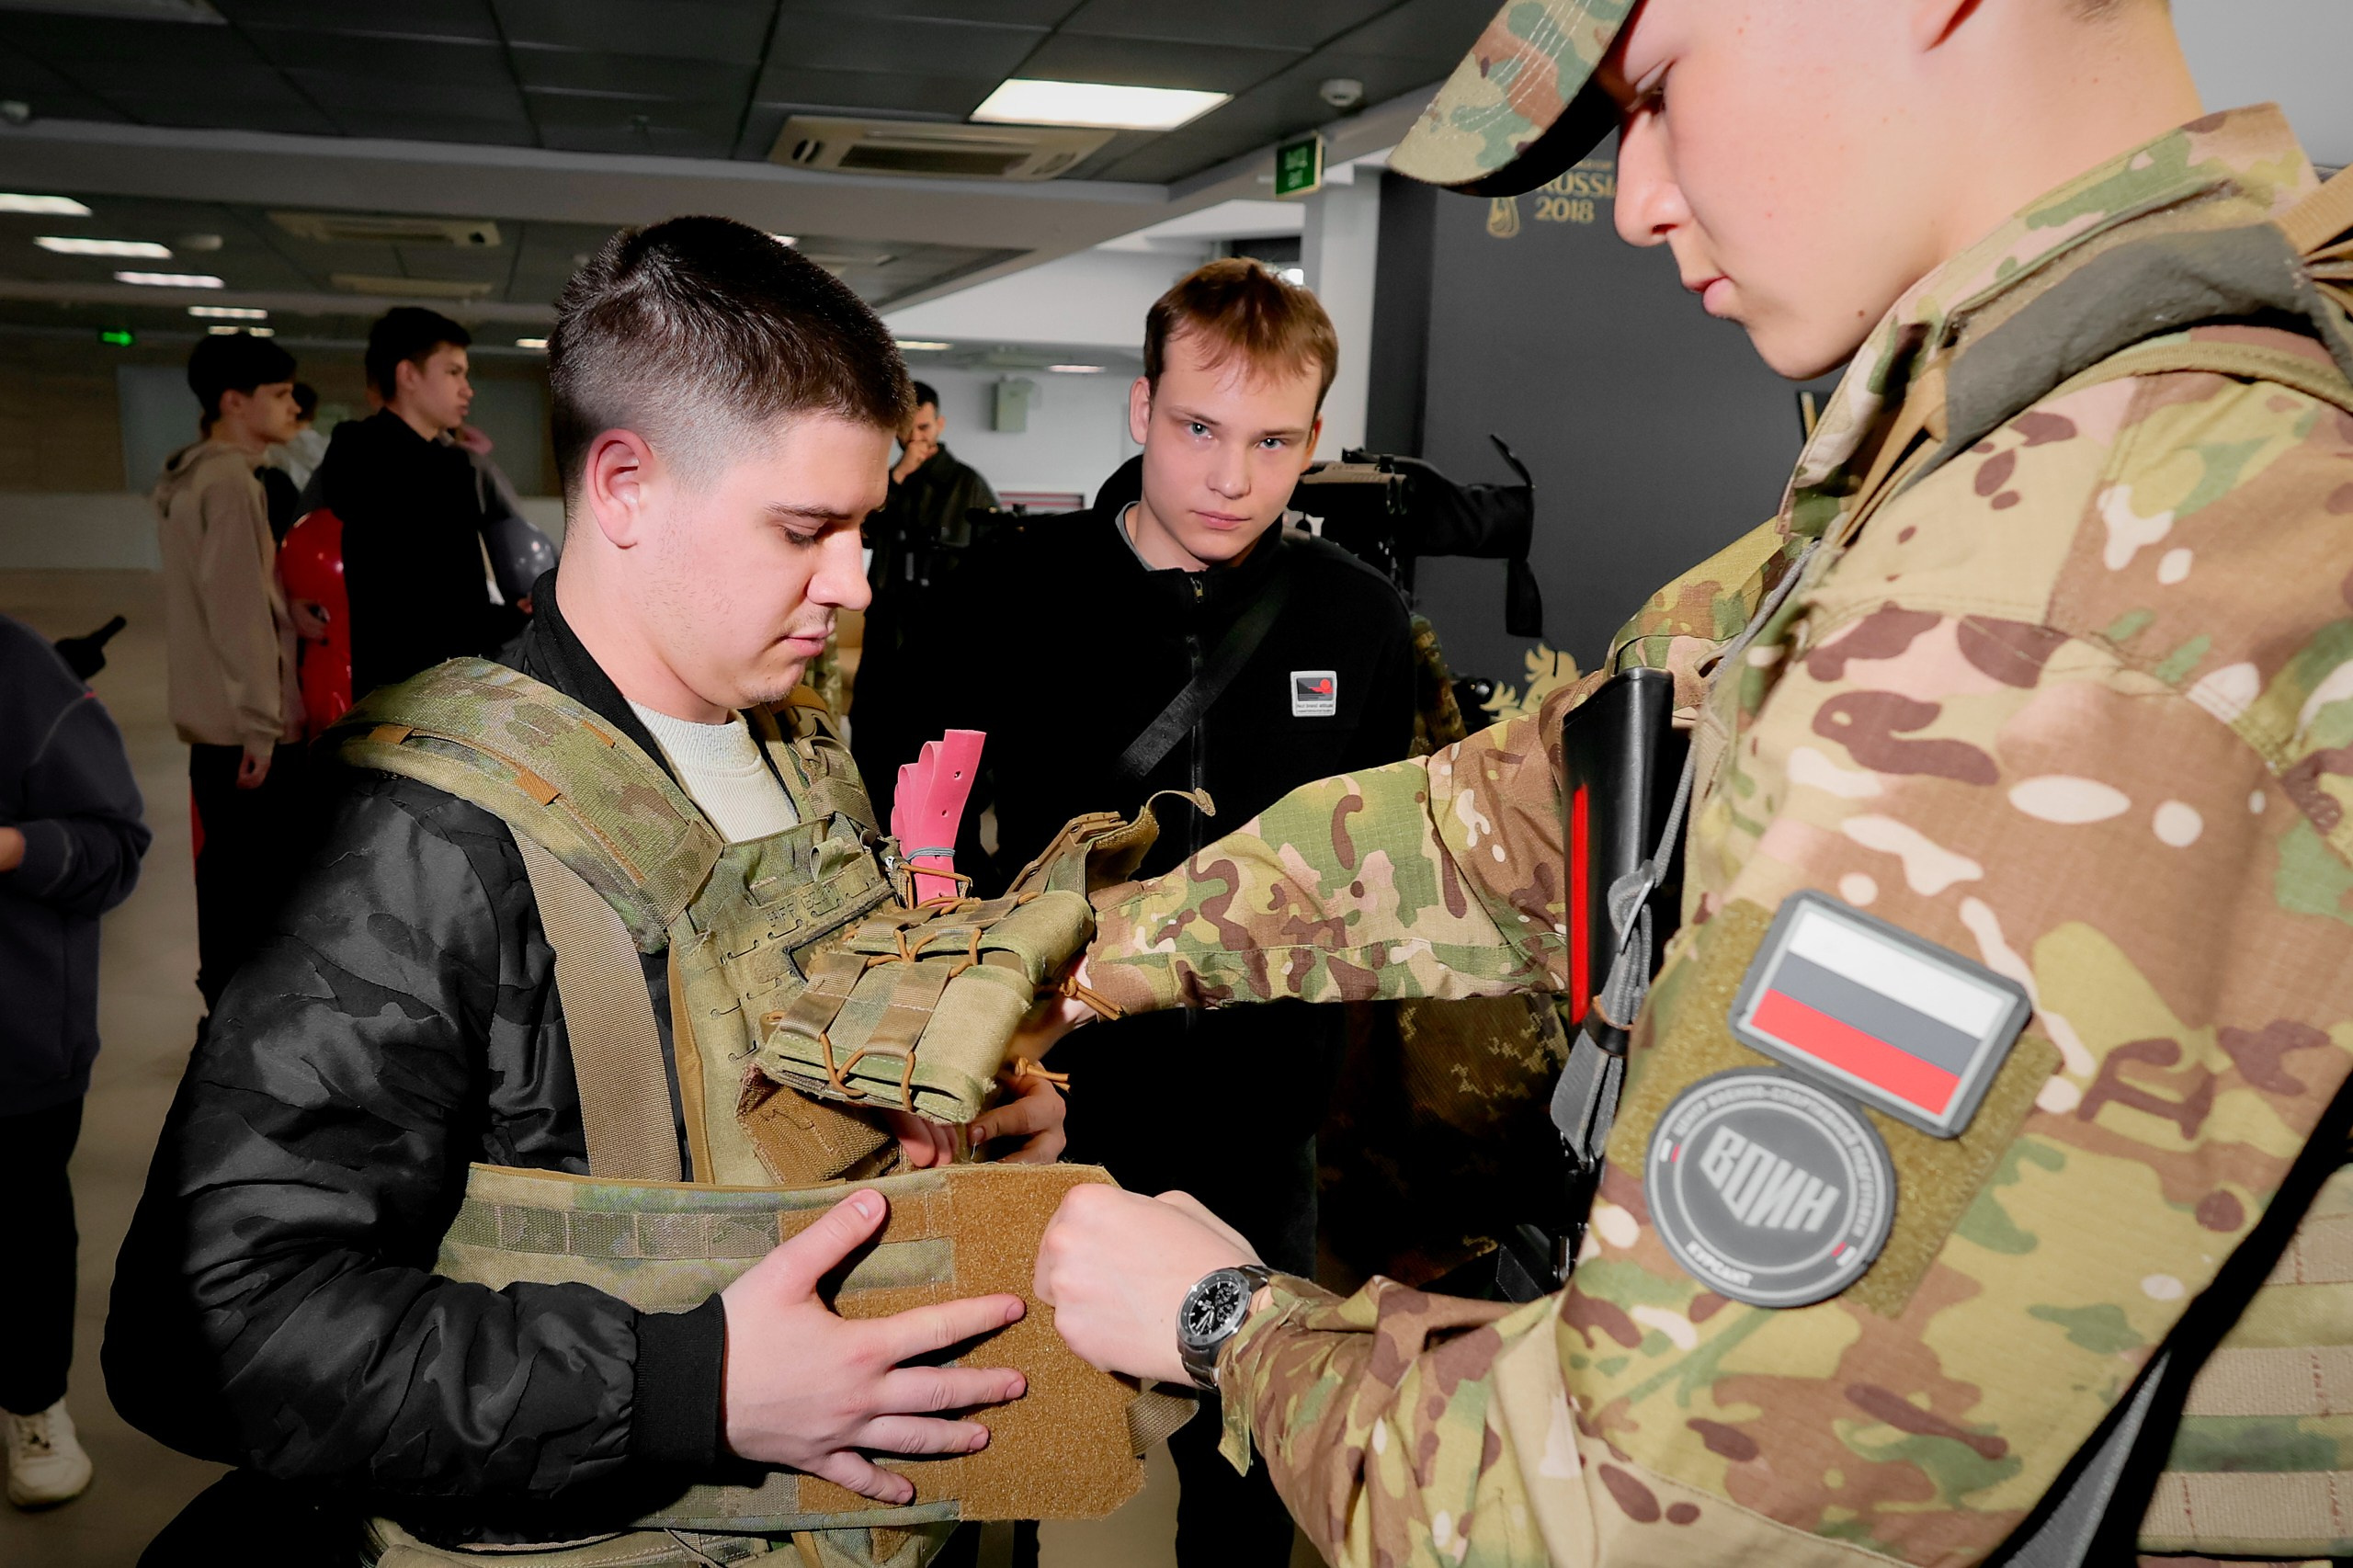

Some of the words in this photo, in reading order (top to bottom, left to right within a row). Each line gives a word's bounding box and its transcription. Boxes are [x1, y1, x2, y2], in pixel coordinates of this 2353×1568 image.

[1536, 172, 1617, 198] USSI
[1534, 196, 1596, 223] 2018
[1699, 1123, 1841, 1233] ВОИН
